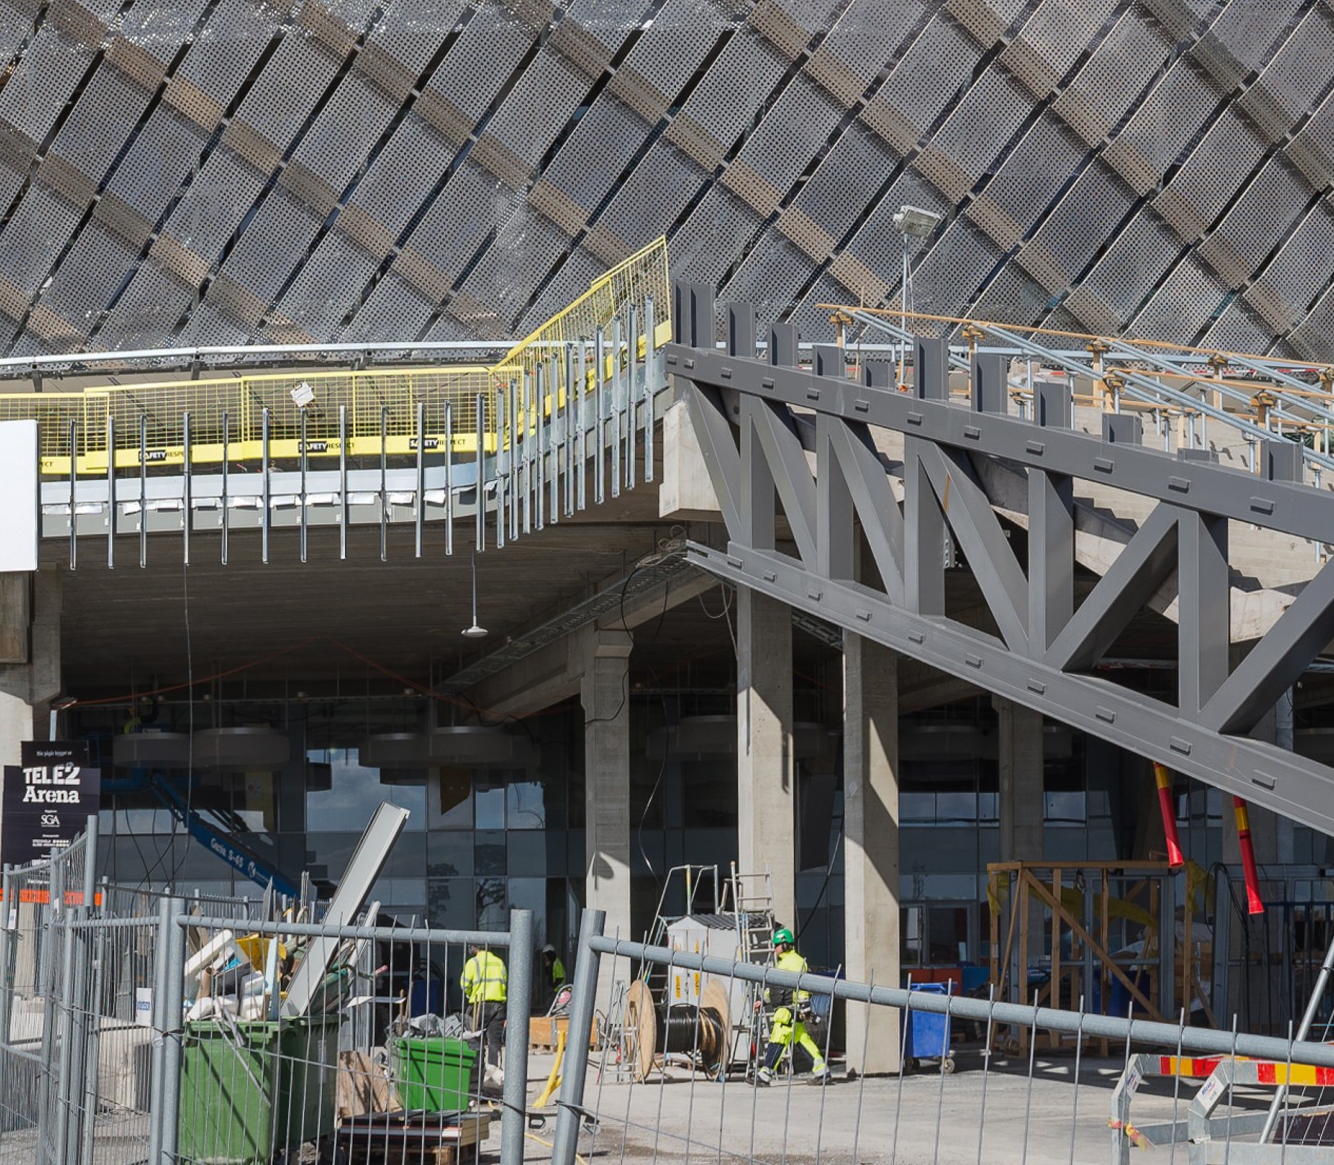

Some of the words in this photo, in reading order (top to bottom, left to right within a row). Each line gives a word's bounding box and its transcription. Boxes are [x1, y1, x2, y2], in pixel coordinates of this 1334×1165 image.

[23, 763, 81, 785] TELE2
[22, 785, 81, 804] Arena
[41, 815, 60, 824] SGA
